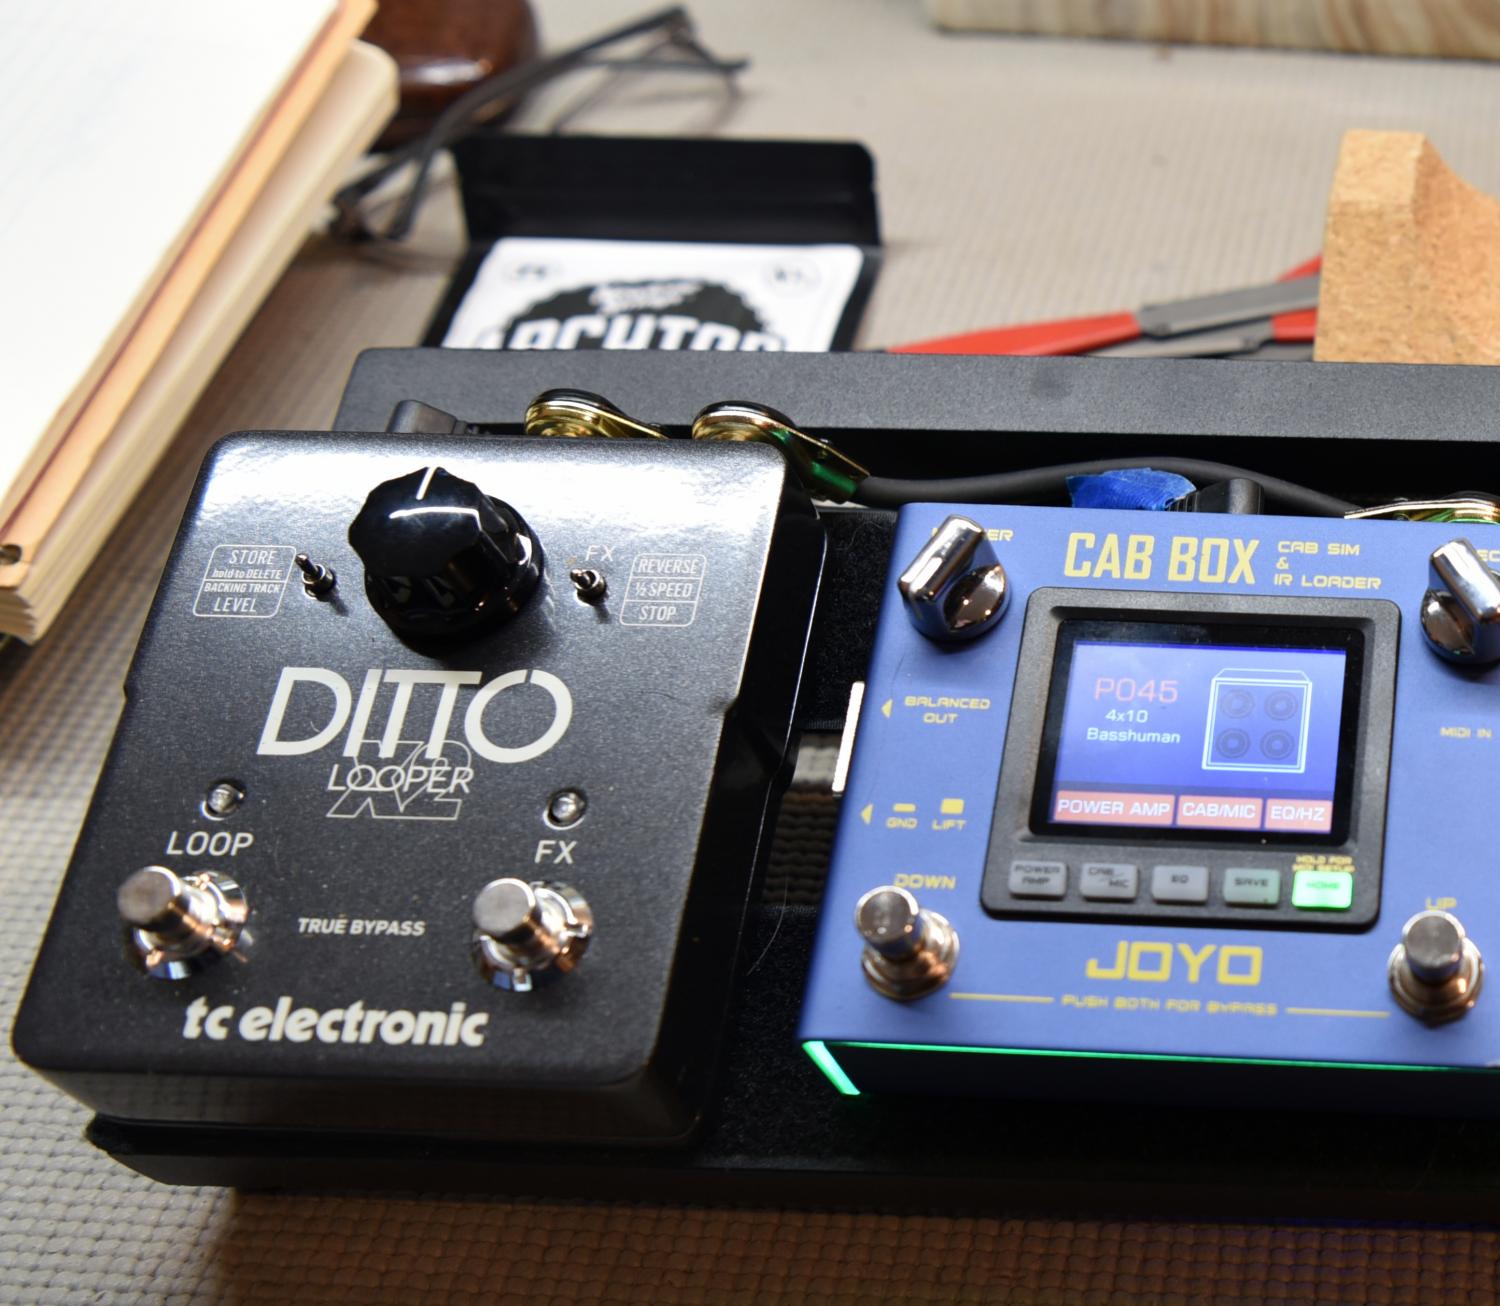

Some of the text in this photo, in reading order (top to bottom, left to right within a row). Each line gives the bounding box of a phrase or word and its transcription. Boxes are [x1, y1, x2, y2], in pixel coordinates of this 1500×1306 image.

[585, 544, 617, 562] FX
[1278, 541, 1360, 556] CAB SIM
[229, 549, 278, 565] STORE
[1064, 532, 1260, 585] CAB BOX
[1276, 556, 1289, 569] &
[211, 568, 283, 579] hold to DELETE
[638, 558, 698, 574] REVERSE
[204, 582, 282, 593] BACKING TRACK
[1274, 573, 1381, 590] IR LOADER
[213, 597, 257, 612] LEVEL
[639, 605, 677, 621] STOP
[1094, 678, 1178, 704] P045
[904, 695, 991, 710] BALANCED
[256, 667, 573, 764] DITTO
[923, 712, 958, 724] OUT
[1105, 710, 1148, 723] 4x10
[1087, 727, 1181, 744] Basshuman
[326, 763, 474, 794] LOOPER
[1057, 799, 1171, 817] POWER AMP
[1182, 803, 1256, 819] CAB/MIC
[1270, 806, 1325, 822] EQ/HZ
[931, 819, 967, 831] LIFT
[165, 831, 254, 857] LOOP
[534, 840, 577, 864] FX
[1013, 864, 1061, 874] POWER
[893, 873, 956, 890] DOWN
[1425, 897, 1458, 910] UP
[298, 917, 426, 936] TRUE BYPASS
[1086, 940, 1263, 985] JOYO
[1061, 994, 1109, 1008] PUSH
[1113, 996, 1160, 1010] BOTH
[182, 996, 489, 1047] tc electronic
